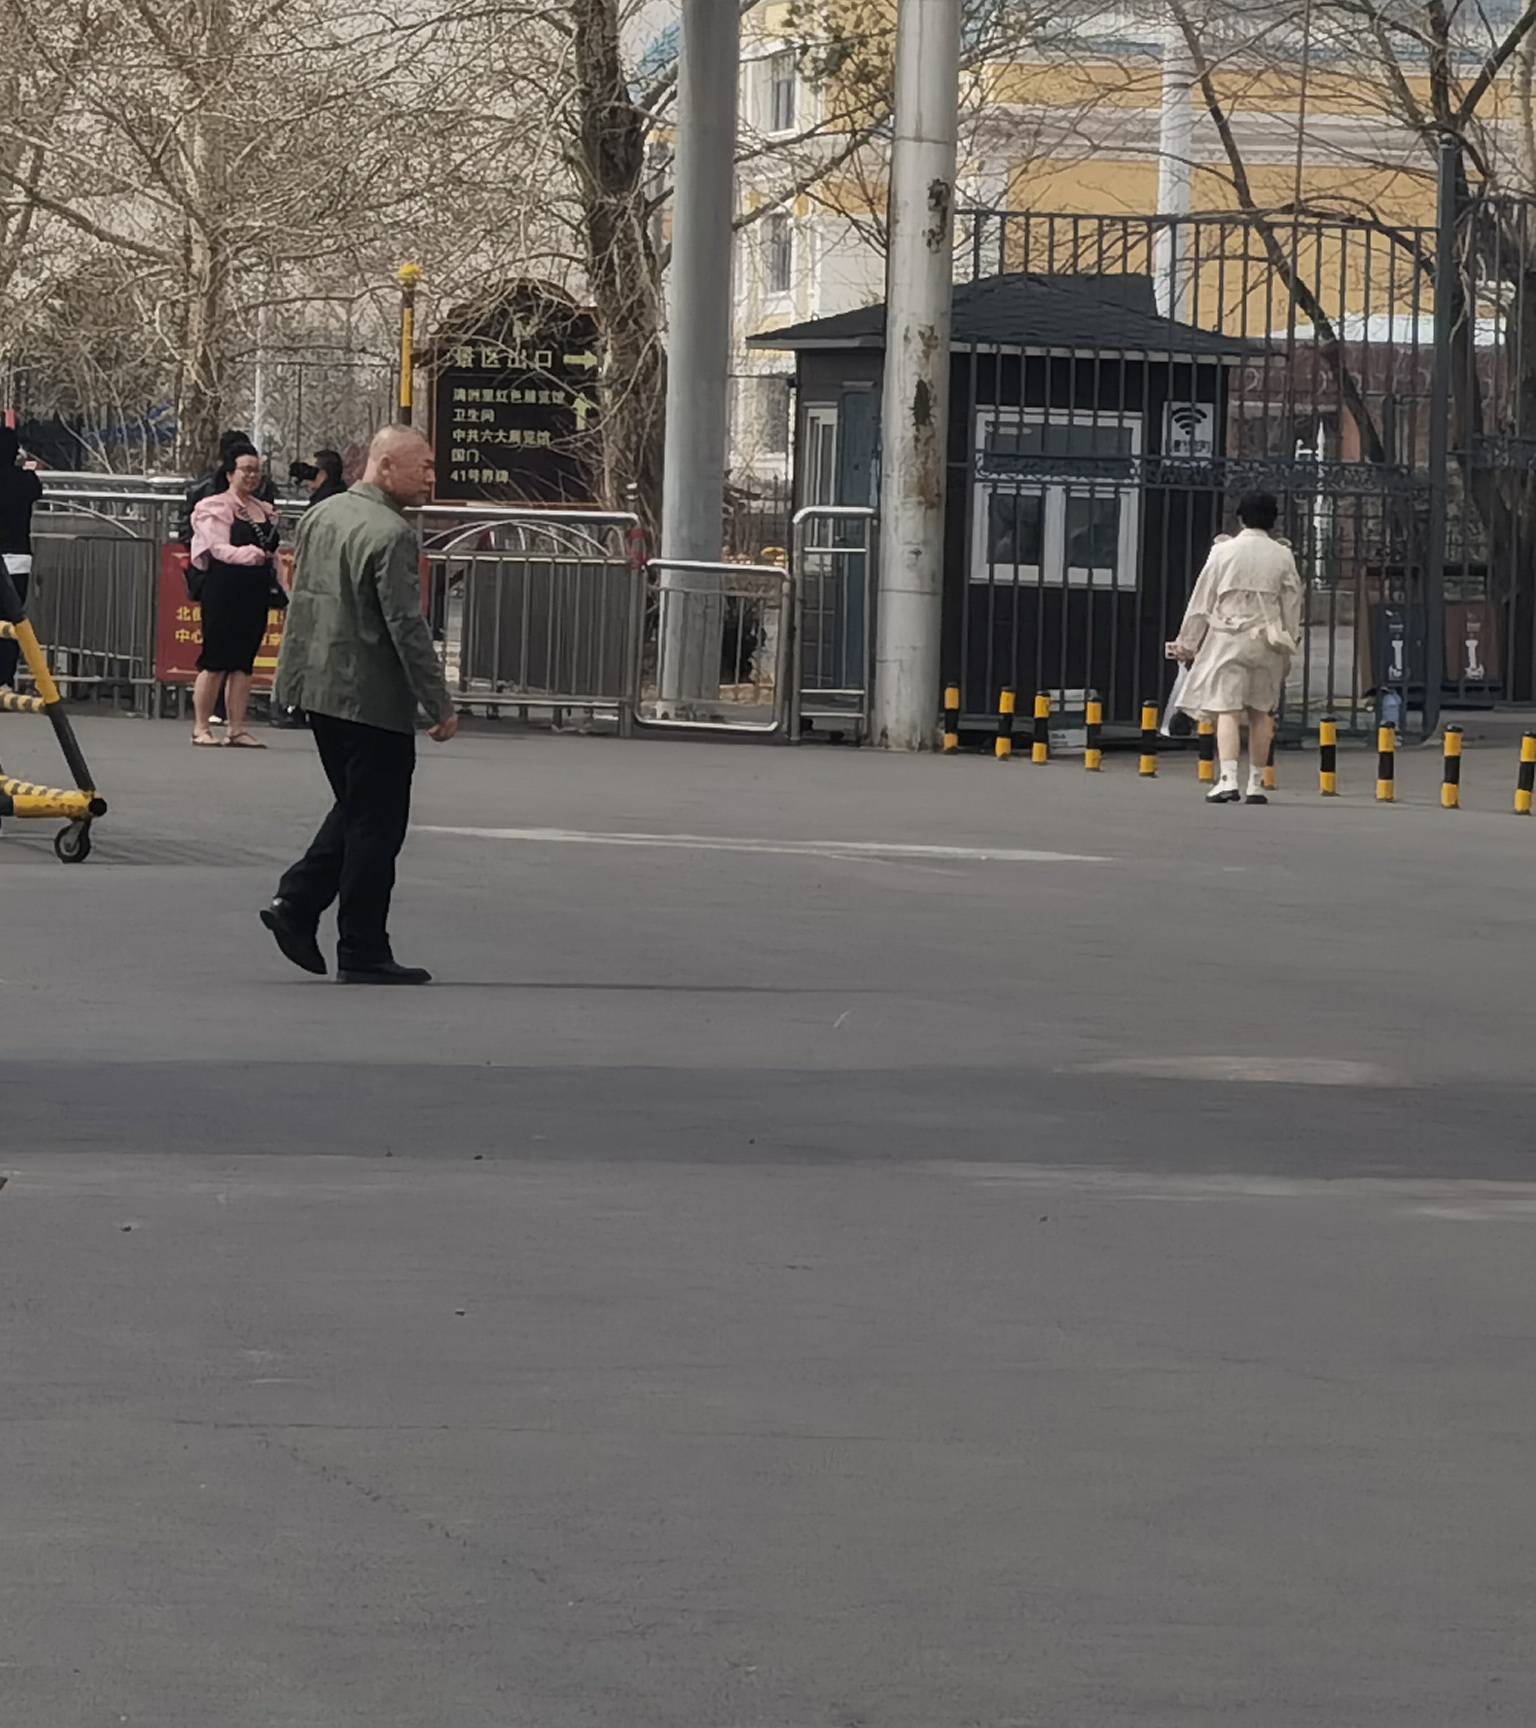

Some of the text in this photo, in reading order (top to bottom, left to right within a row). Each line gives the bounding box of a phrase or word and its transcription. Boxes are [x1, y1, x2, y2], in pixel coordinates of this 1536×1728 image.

[453, 345, 553, 369] 景区出口
[452, 408, 495, 422] 卫生间
[452, 428, 551, 446] 中共六大展览馆
[451, 448, 479, 463] 国门
